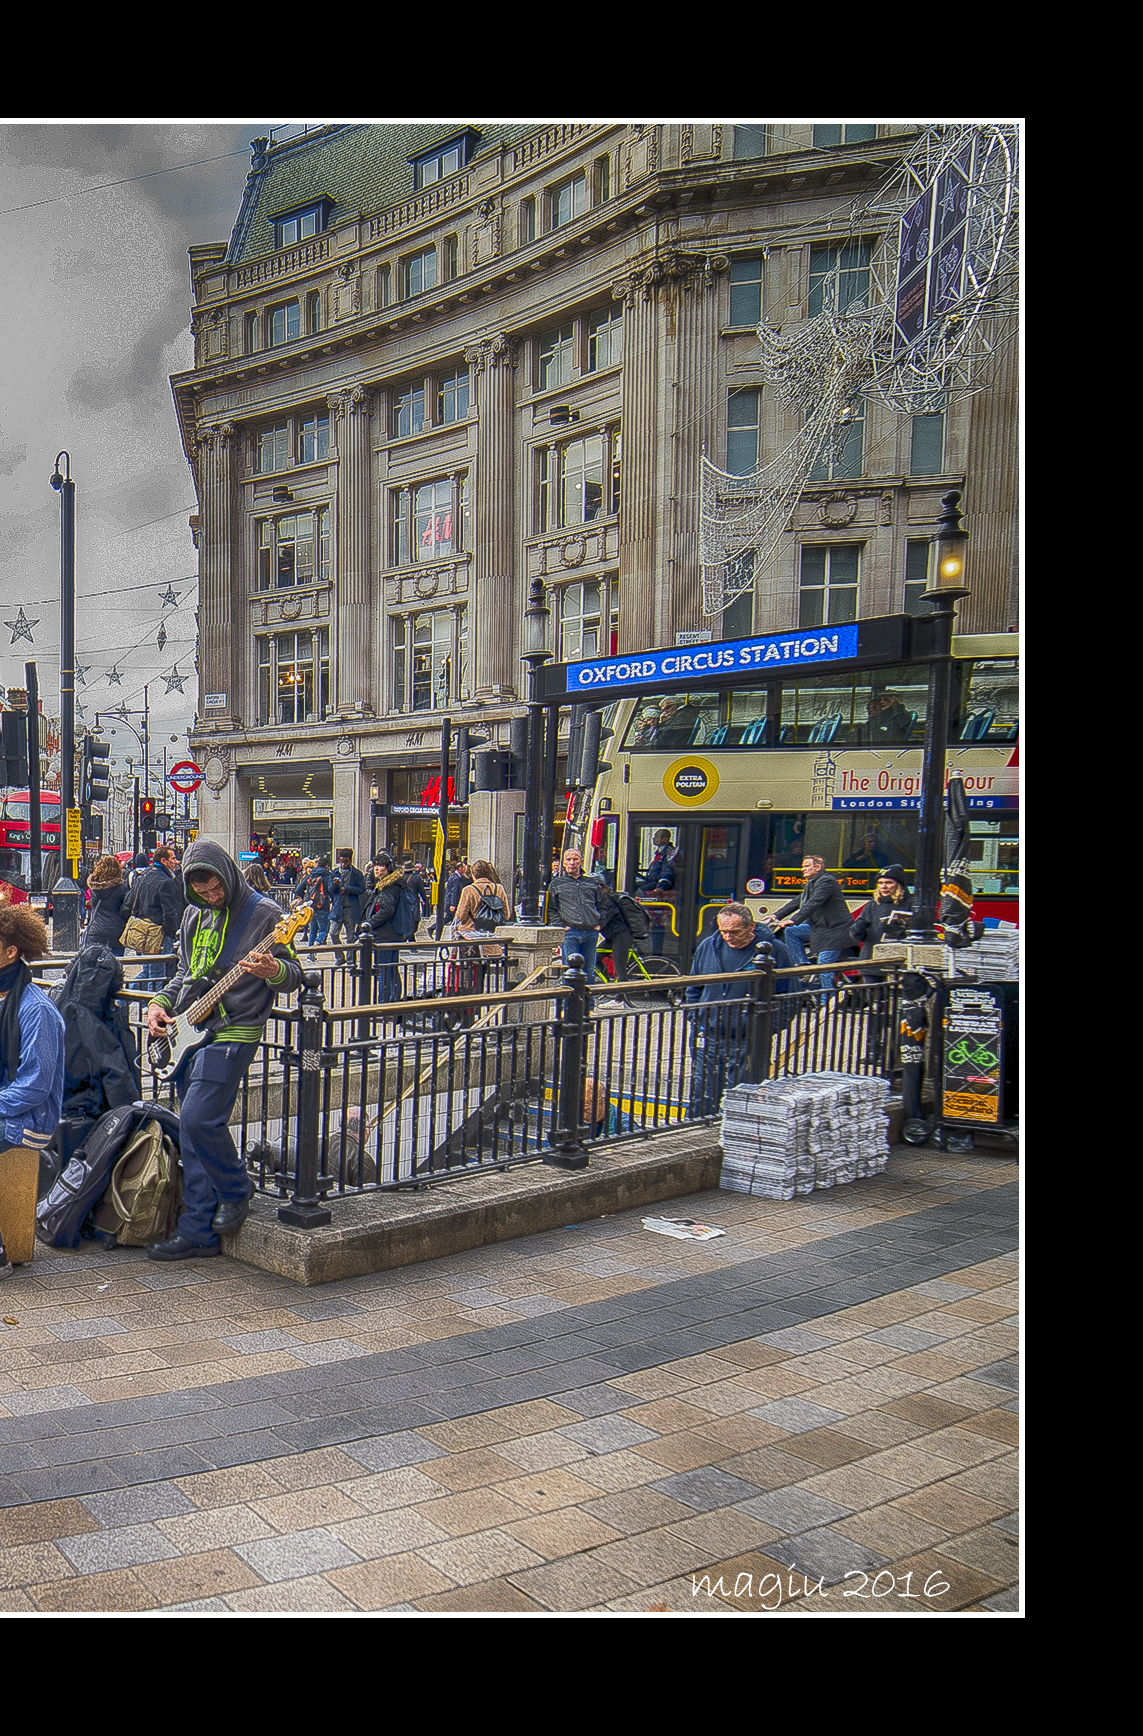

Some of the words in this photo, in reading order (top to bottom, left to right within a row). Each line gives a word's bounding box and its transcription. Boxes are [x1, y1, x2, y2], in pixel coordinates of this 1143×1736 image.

[578, 660, 657, 685] OXFORD
[660, 649, 734, 675] CIRCUS
[739, 635, 839, 665] STATION
[841, 769, 870, 791] The
[877, 768, 950, 796] Origil
[841, 799, 893, 808] London
[46, 833, 56, 844] 10
[846, 877, 869, 886] Tour
